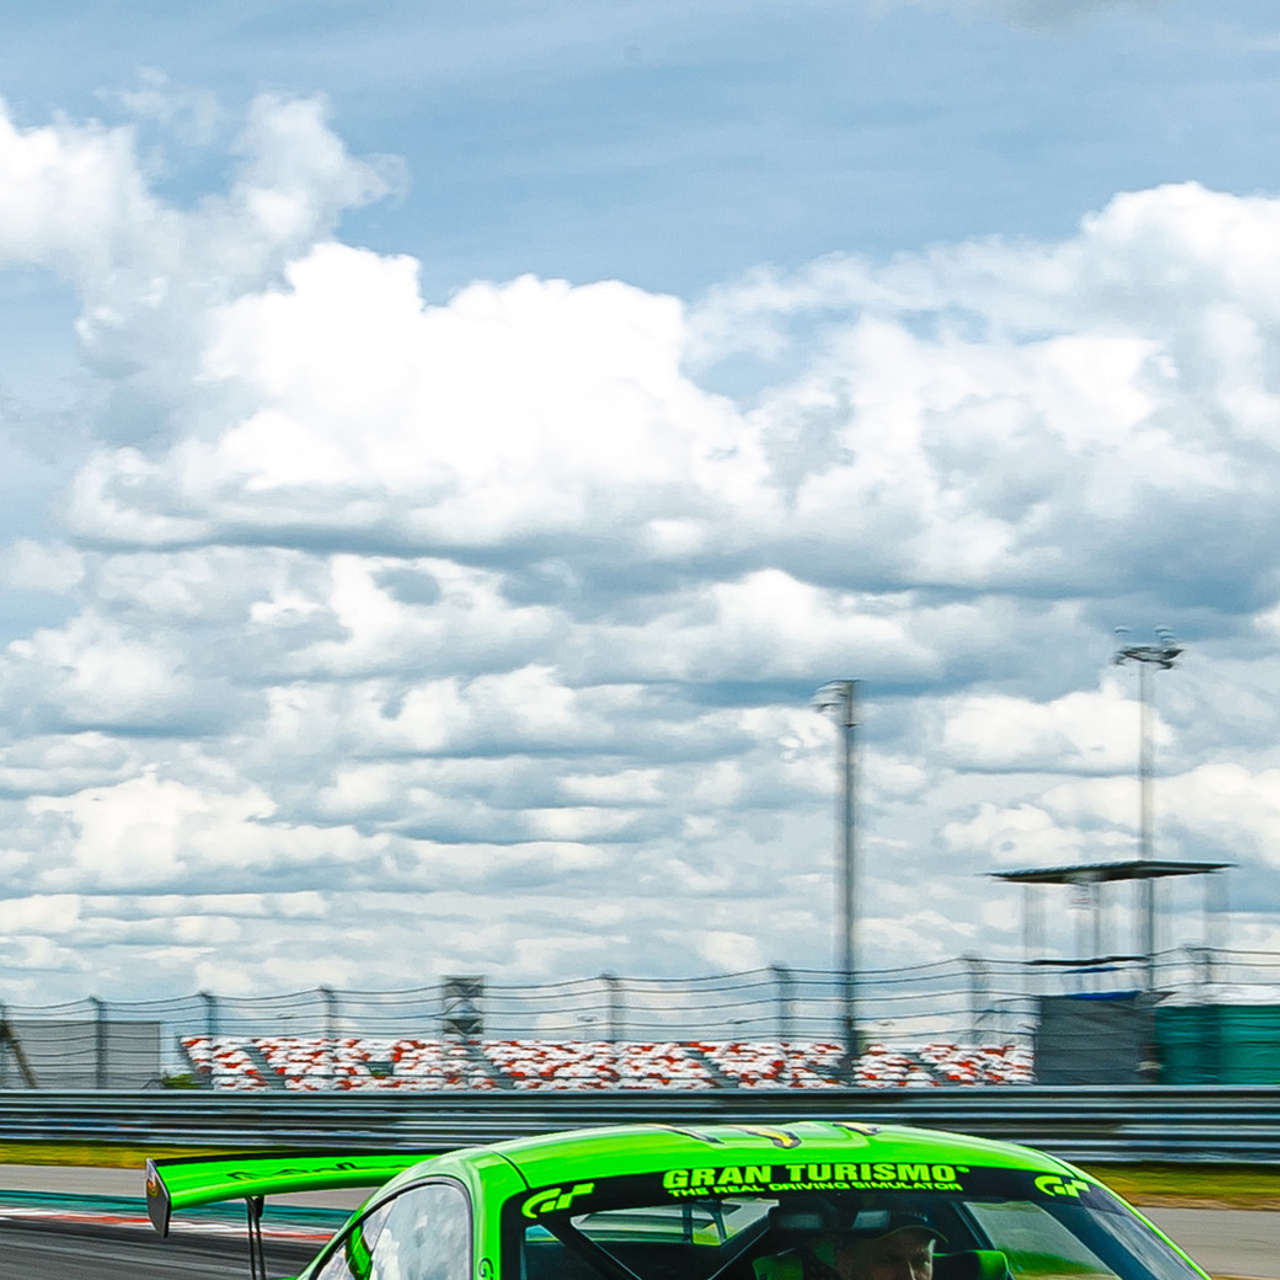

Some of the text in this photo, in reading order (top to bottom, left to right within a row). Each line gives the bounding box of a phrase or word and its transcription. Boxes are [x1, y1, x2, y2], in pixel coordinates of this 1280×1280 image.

[663, 1166, 771, 1188] GRAN
[669, 1181, 963, 1197] THE REAL DRIVING SIMULATOR
